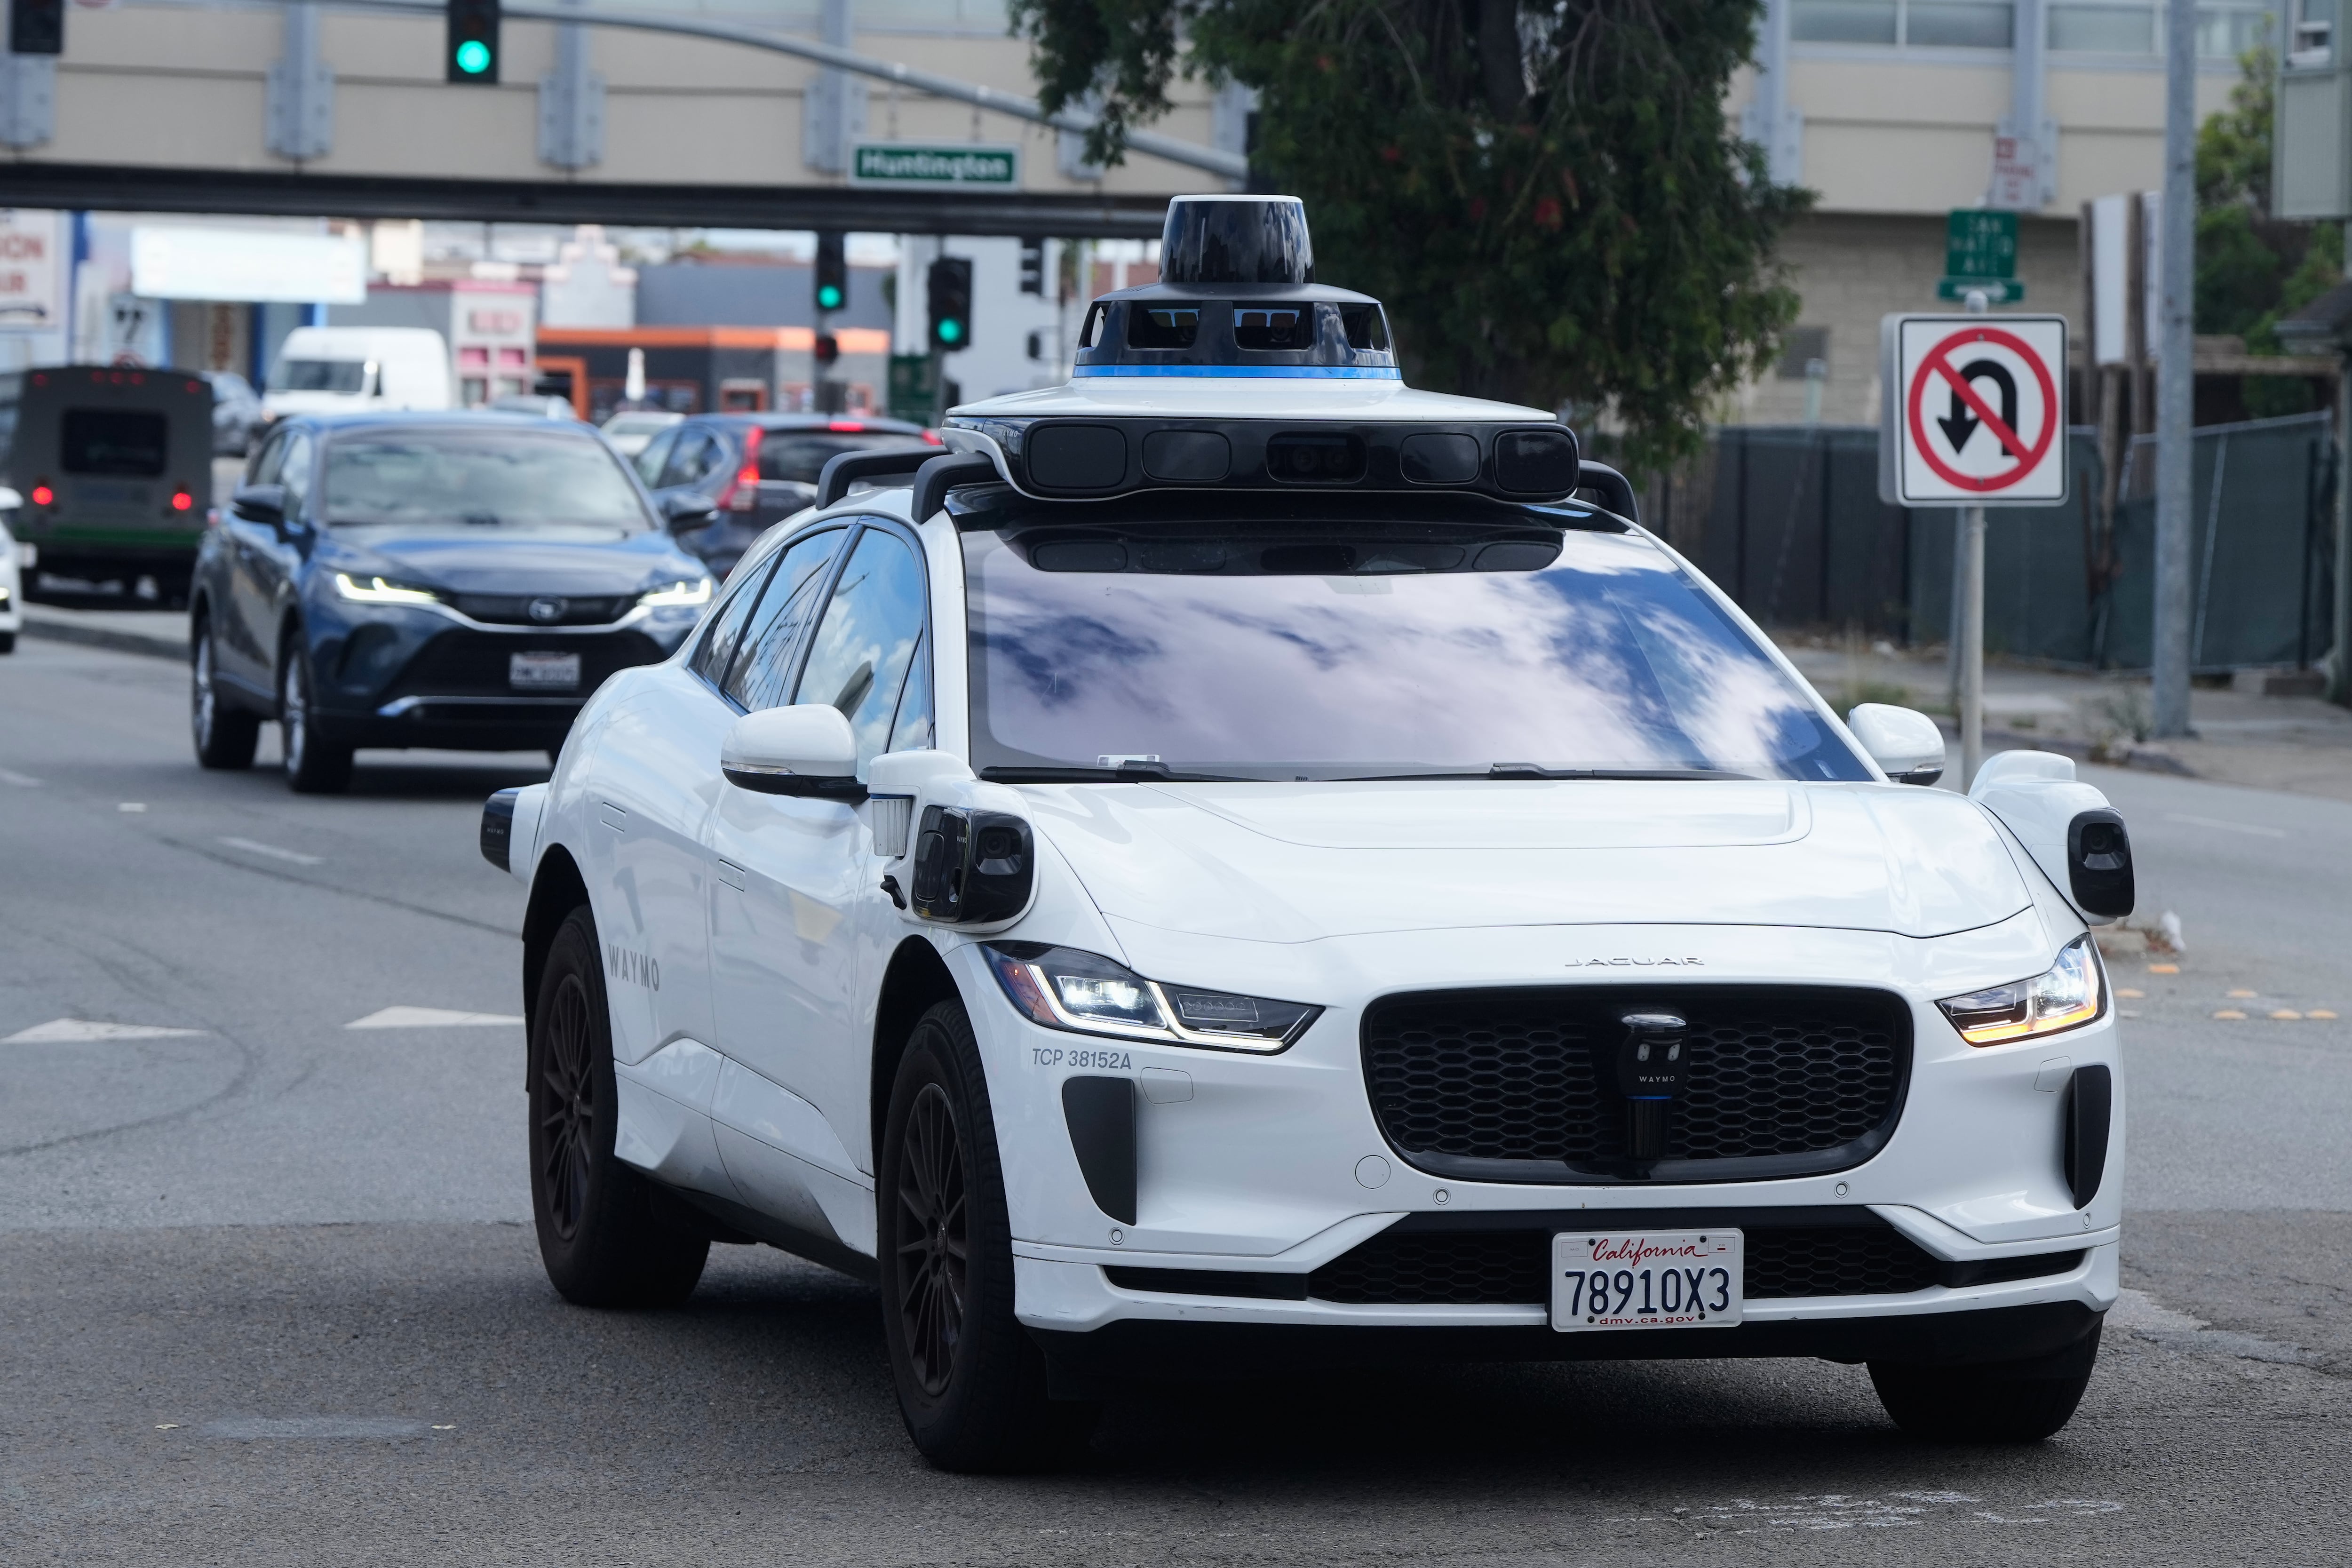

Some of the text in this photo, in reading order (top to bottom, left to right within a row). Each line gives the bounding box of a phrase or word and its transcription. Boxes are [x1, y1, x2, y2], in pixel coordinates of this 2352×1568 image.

[861, 149, 1008, 180] Huntington
[999, 429, 1018, 438] WAYMO
[608, 943, 660, 992] WAYMO
[1565, 957, 1705, 967] JAGUAR
[1033, 1048, 1131, 1070] TCP 38152A
[1593, 1238, 1708, 1266] California
[1565, 1267, 1730, 1316] 78910X3
[1599, 1316, 1695, 1325] dmv.ca.gov
